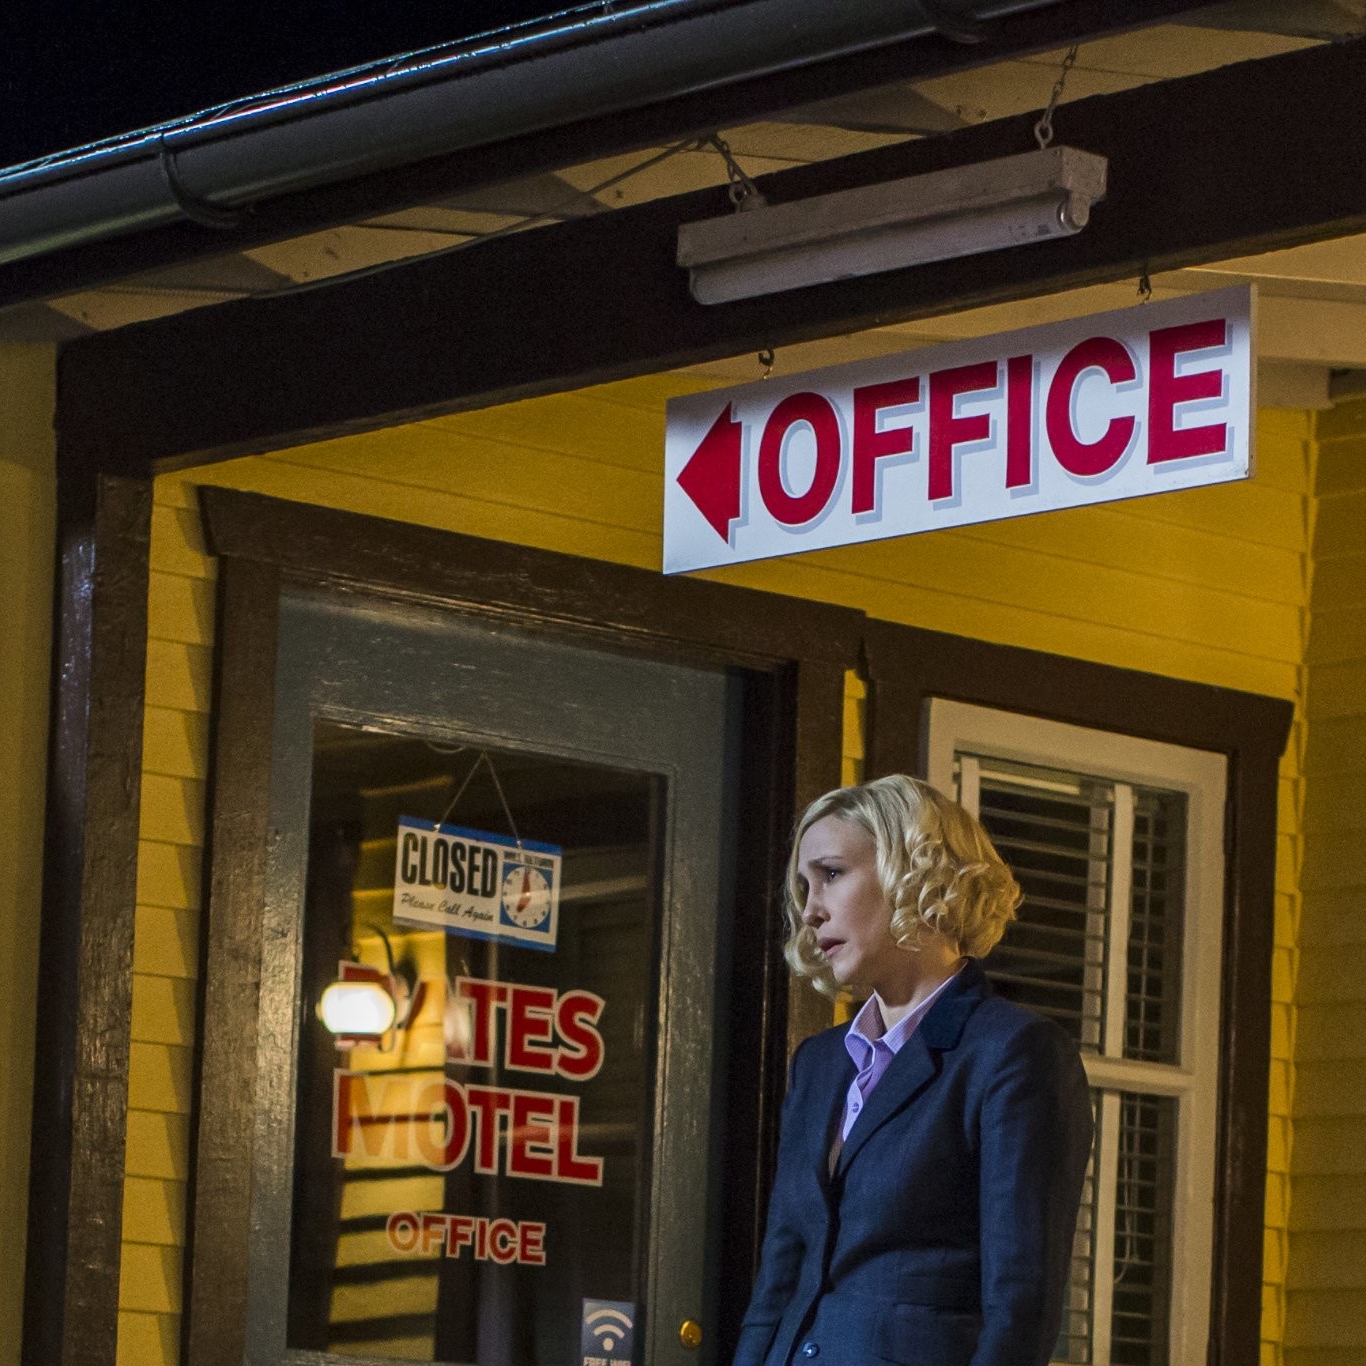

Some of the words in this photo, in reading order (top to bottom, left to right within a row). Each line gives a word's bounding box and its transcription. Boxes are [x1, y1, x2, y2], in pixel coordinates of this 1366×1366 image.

[757, 318, 1232, 532] OFFICE
[401, 832, 499, 899] CLOSED
[401, 892, 435, 911] Please
[437, 899, 461, 915] Call
[461, 905, 494, 923] Again
[337, 959, 606, 1081] TES
[331, 1067, 604, 1187] MOTEL
[387, 1210, 547, 1267] OFFICE
